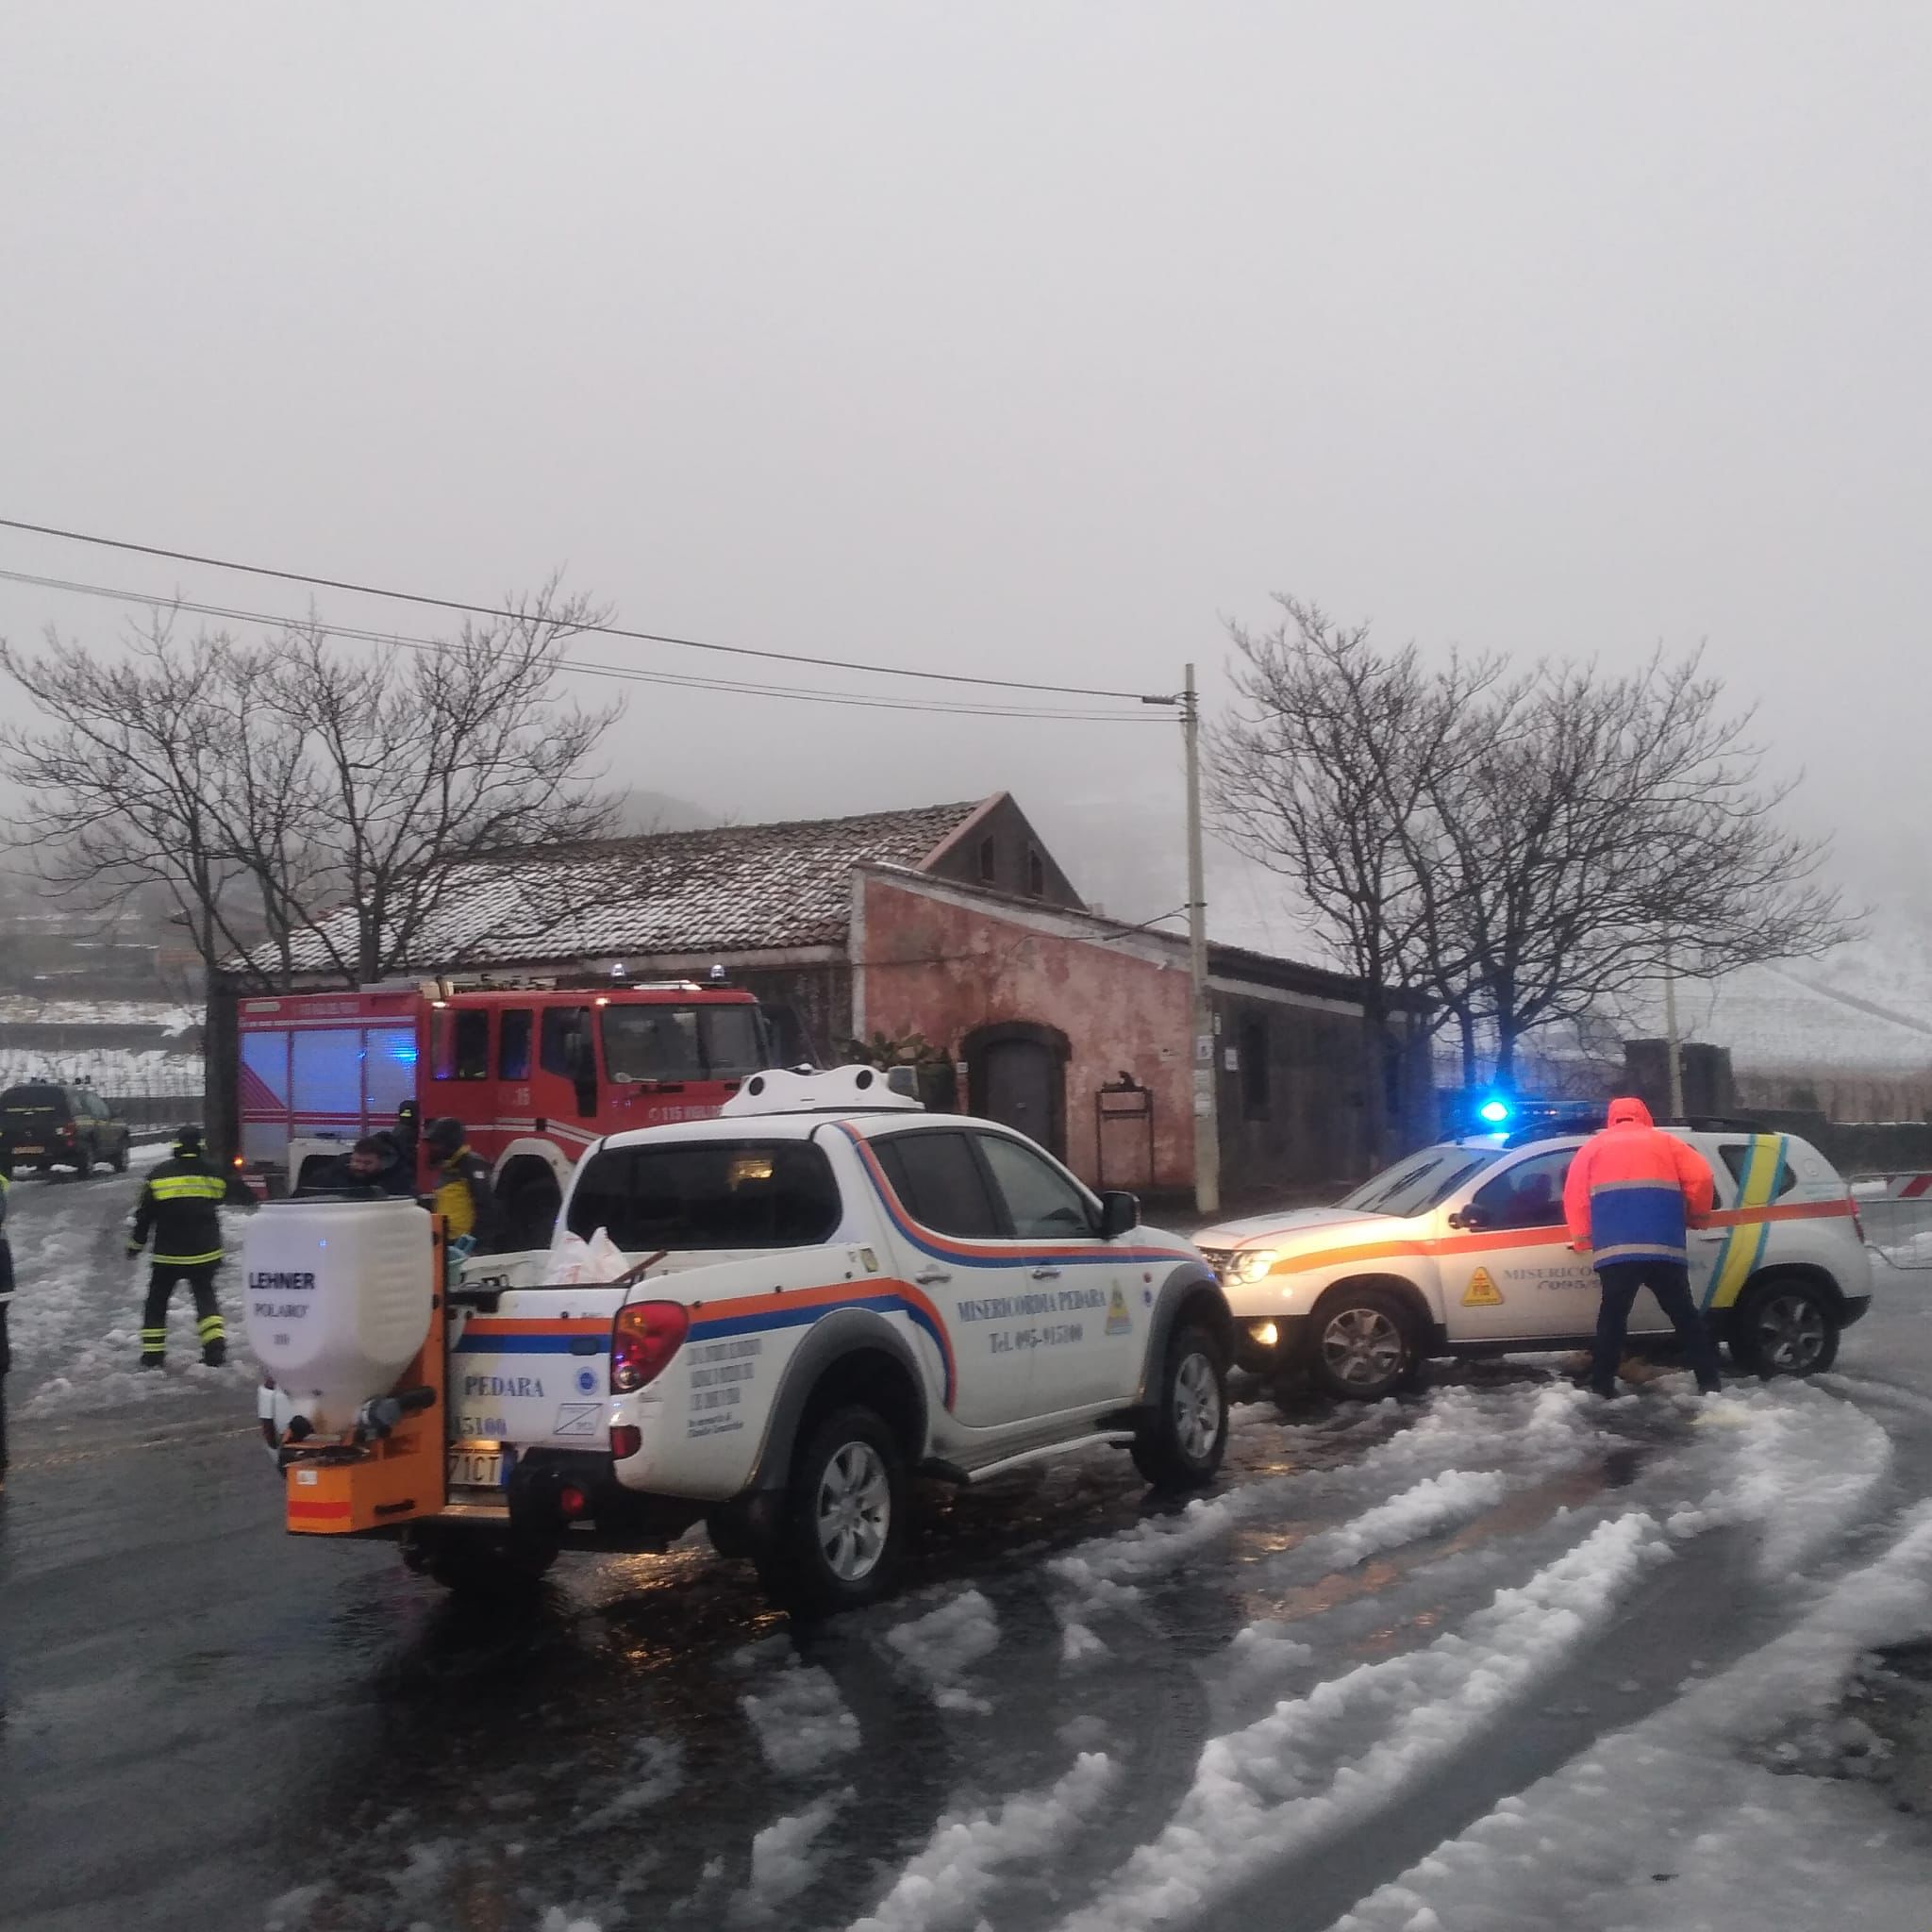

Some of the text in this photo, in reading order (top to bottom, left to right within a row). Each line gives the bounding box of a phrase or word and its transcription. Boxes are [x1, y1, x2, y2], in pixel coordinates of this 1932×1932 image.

[249, 1272, 315, 1291] LEHNER
[958, 1289, 1107, 1323] MISERICORDIA PEDARA
[464, 1375, 544, 1397] PEDARA
